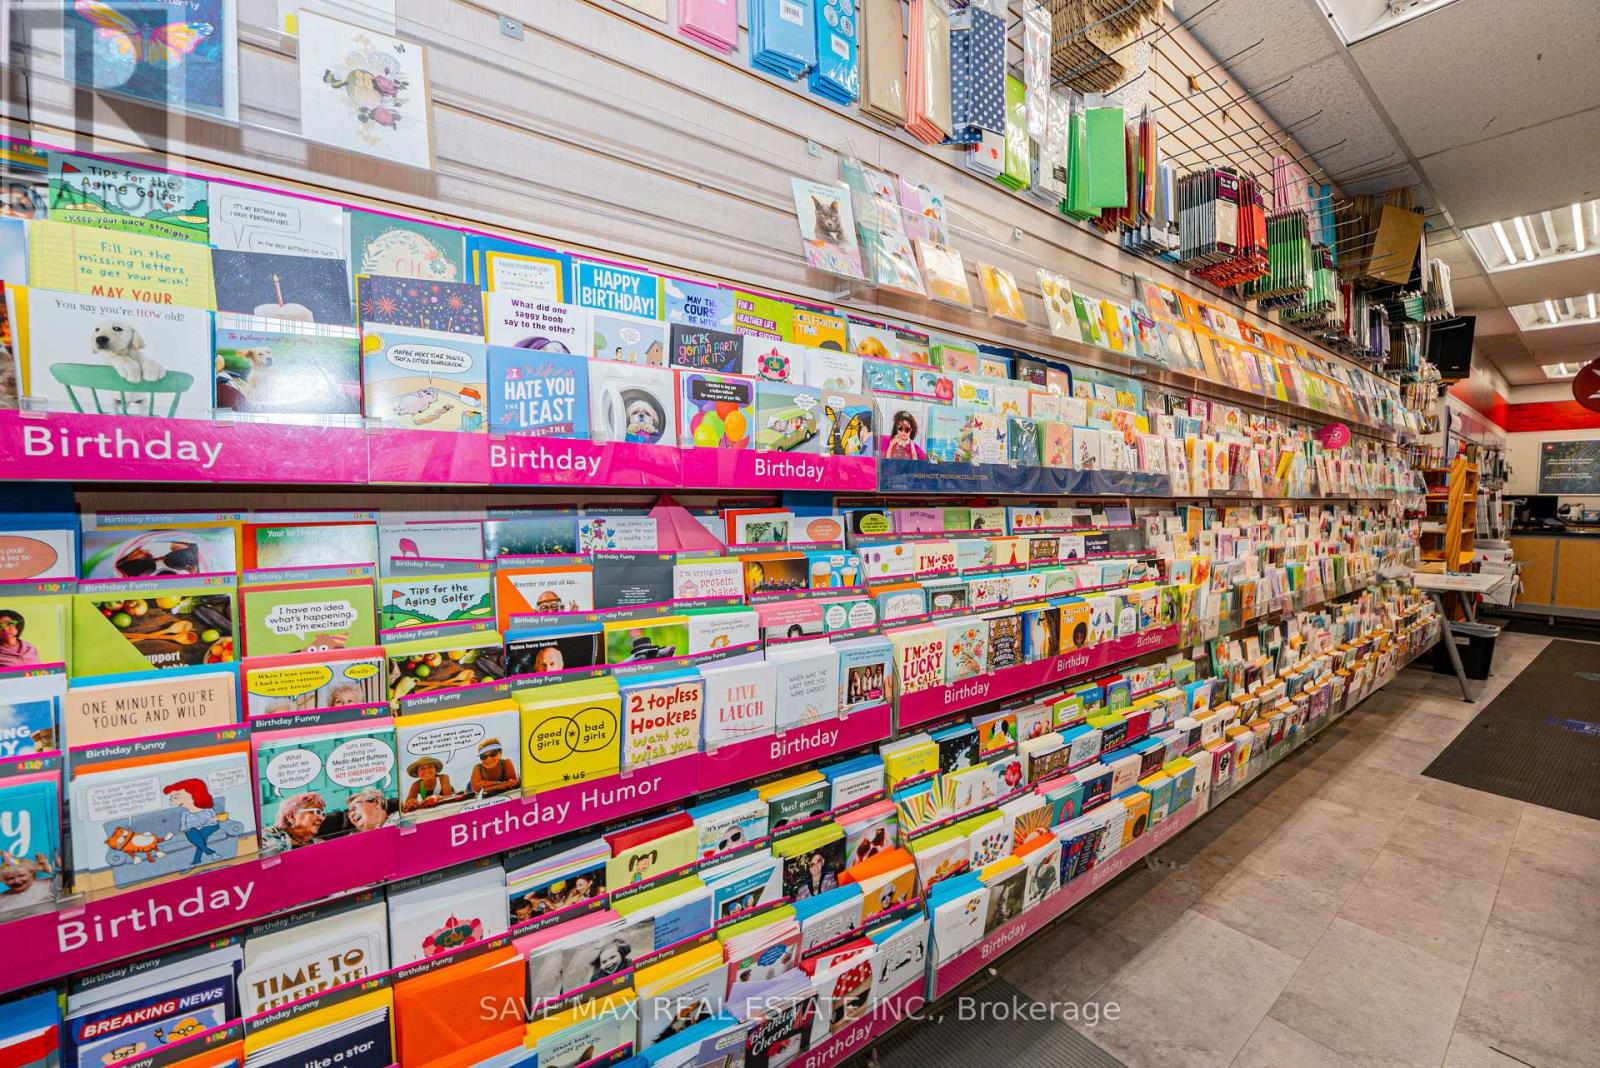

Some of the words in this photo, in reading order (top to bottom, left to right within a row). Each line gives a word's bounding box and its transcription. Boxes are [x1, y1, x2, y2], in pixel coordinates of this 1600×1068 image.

[88, 166, 119, 180] Tips
[125, 170, 145, 185] for
[151, 174, 178, 190] the
[82, 176, 128, 194] Aging
[137, 186, 186, 203] Golfer
[96, 217, 118, 228] your
[122, 218, 146, 229] back
[150, 222, 191, 240] straight
[101, 241, 121, 254] Fill
[129, 246, 144, 256] in
[150, 250, 171, 261] the
[78, 254, 135, 269] missing
[141, 256, 184, 274] letters
[80, 266, 93, 275] to
[99, 267, 120, 281] get
[127, 271, 153, 286] your
[158, 275, 190, 287] wish!
[594, 269, 641, 295] HAPPY
[91, 284, 124, 299] MAY
[132, 289, 173, 306] YOUR
[582, 286, 656, 317] BIRTHDAY!
[687, 295, 703, 306] MAY
[737, 300, 749, 309] FOR
[55, 299, 77, 310] You
[80, 301, 97, 315] say
[100, 304, 134, 317] you're
[136, 308, 163, 320] HOW
[165, 311, 186, 322] old?
[511, 298, 535, 310] What
[536, 301, 551, 313] did
[552, 305, 568, 315] one
[515, 309, 541, 322] saggy
[542, 311, 564, 324] boob
[504, 317, 519, 328] say
[521, 318, 530, 329] to
[532, 321, 547, 332] the
[548, 323, 576, 336] other?
[797, 314, 845, 330] CELEBRATION
[799, 325, 819, 336] TIME
[693, 354, 710, 367] LIKE
[504, 380, 543, 401] HATE
[545, 377, 576, 397] YOU
[520, 398, 576, 428] LEAST
[549, 425, 566, 434] THE
[23, 425, 224, 469] Birthday
[490, 445, 603, 477] Birthday
[755, 458, 825, 482] Birthday
[104, 515, 143, 525] Birthday
[145, 514, 174, 524] Funny
[920, 554, 935, 571] I'M
[941, 553, 955, 564] SO
[85, 582, 127, 593] Birthday
[129, 581, 159, 592] Funny
[409, 587, 430, 595] Tips
[433, 585, 449, 594] for
[451, 583, 469, 592] the
[286, 605, 309, 614] have
[310, 605, 322, 613] no
[324, 603, 345, 612] idea
[404, 597, 437, 608] Aging
[441, 593, 476, 604] Golfer
[269, 614, 302, 625] what's
[277, 624, 293, 633] but
[295, 622, 310, 631] I'm
[310, 620, 349, 630] excited!
[1137, 633, 1163, 648] Birthday
[904, 645, 922, 663] I'M
[928, 641, 943, 654] SO
[1057, 654, 1090, 671] Birthday
[903, 651, 943, 682] LUCKY
[517, 678, 543, 686] Birthday
[544, 675, 563, 685] Funny
[917, 673, 938, 688] CALL
[82, 702, 108, 716] ONE
[116, 694, 165, 711] MINUTE
[172, 689, 216, 705] YOU'RE
[407, 696, 438, 707] Birthday
[439, 692, 462, 702] Funny
[727, 683, 758, 703] LIVE
[944, 680, 991, 705] Birthday
[631, 695, 646, 714] 2
[719, 701, 764, 723] LAUGH
[92, 712, 139, 729] YOUNG
[145, 708, 171, 722] AND
[177, 704, 208, 718] WILD
[256, 718, 294, 729] Birthday
[295, 714, 322, 725] Funny
[584, 721, 606, 733] bad
[537, 728, 562, 742] good
[537, 739, 561, 751] girls
[583, 731, 607, 744] girls
[632, 732, 670, 749] want
[674, 727, 690, 740] to
[770, 729, 840, 760] Birthday
[86, 746, 133, 759] Birthday
[135, 741, 168, 752] Funny
[285, 753, 303, 763] What
[631, 744, 668, 765] wish
[348, 766, 387, 778] FIREFIGHTERS
[450, 799, 571, 849] Birthday
[580, 776, 663, 812] Humor
[780, 800, 798, 814] Sweet
[1153, 819, 1180, 842] Birthday
[1092, 857, 1124, 886] Birthday
[57, 881, 255, 953] Birthday
[513, 921, 541, 936] Birthday
[541, 914, 561, 927] Funny
[981, 920, 1028, 960] Birthday
[398, 963, 431, 979] Birthday
[431, 954, 454, 968] Funny
[635, 954, 659, 969] Birthday
[658, 948, 676, 960] Funny
[81, 967, 128, 987] Birthday
[130, 958, 162, 973] Funny
[253, 962, 322, 999] TIME
[328, 949, 364, 972] TO
[83, 1000, 176, 1039] BREAKING
[179, 987, 224, 1009] NEWS
[253, 1009, 292, 1028] Birthday
[293, 998, 320, 1012] Funny
[334, 1052, 345, 1062] a
[346, 1039, 375, 1058] star
[805, 1022, 874, 1068] Birthday
